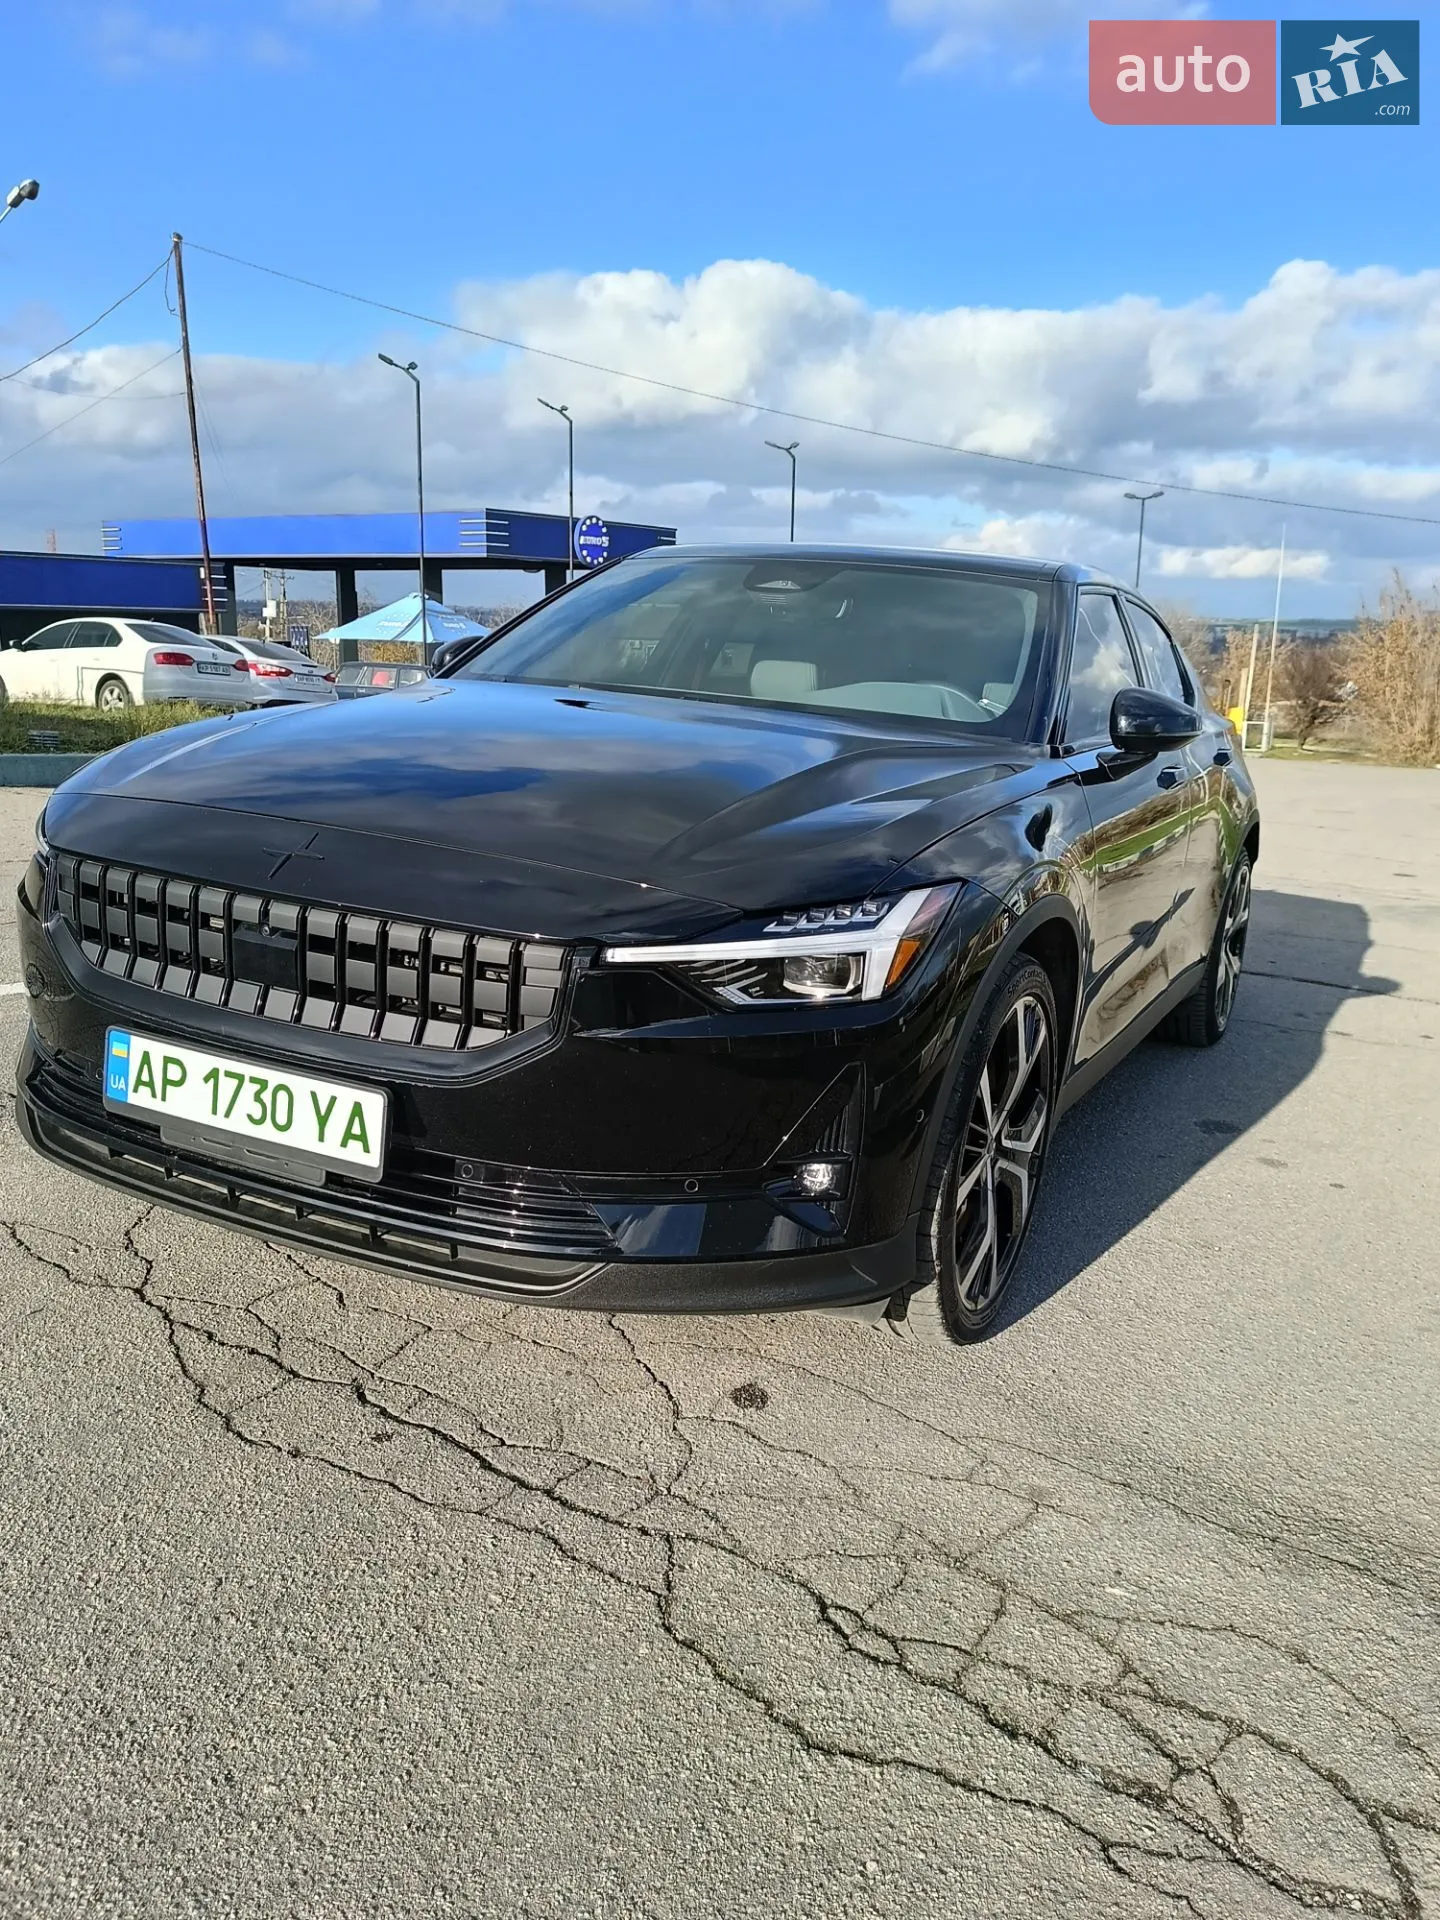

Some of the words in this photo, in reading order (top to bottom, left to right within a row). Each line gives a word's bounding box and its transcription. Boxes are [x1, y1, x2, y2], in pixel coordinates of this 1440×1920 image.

[110, 1075, 126, 1091] UA
[133, 1050, 188, 1102] AP
[203, 1067, 294, 1132] 1730
[310, 1090, 371, 1154] YA
